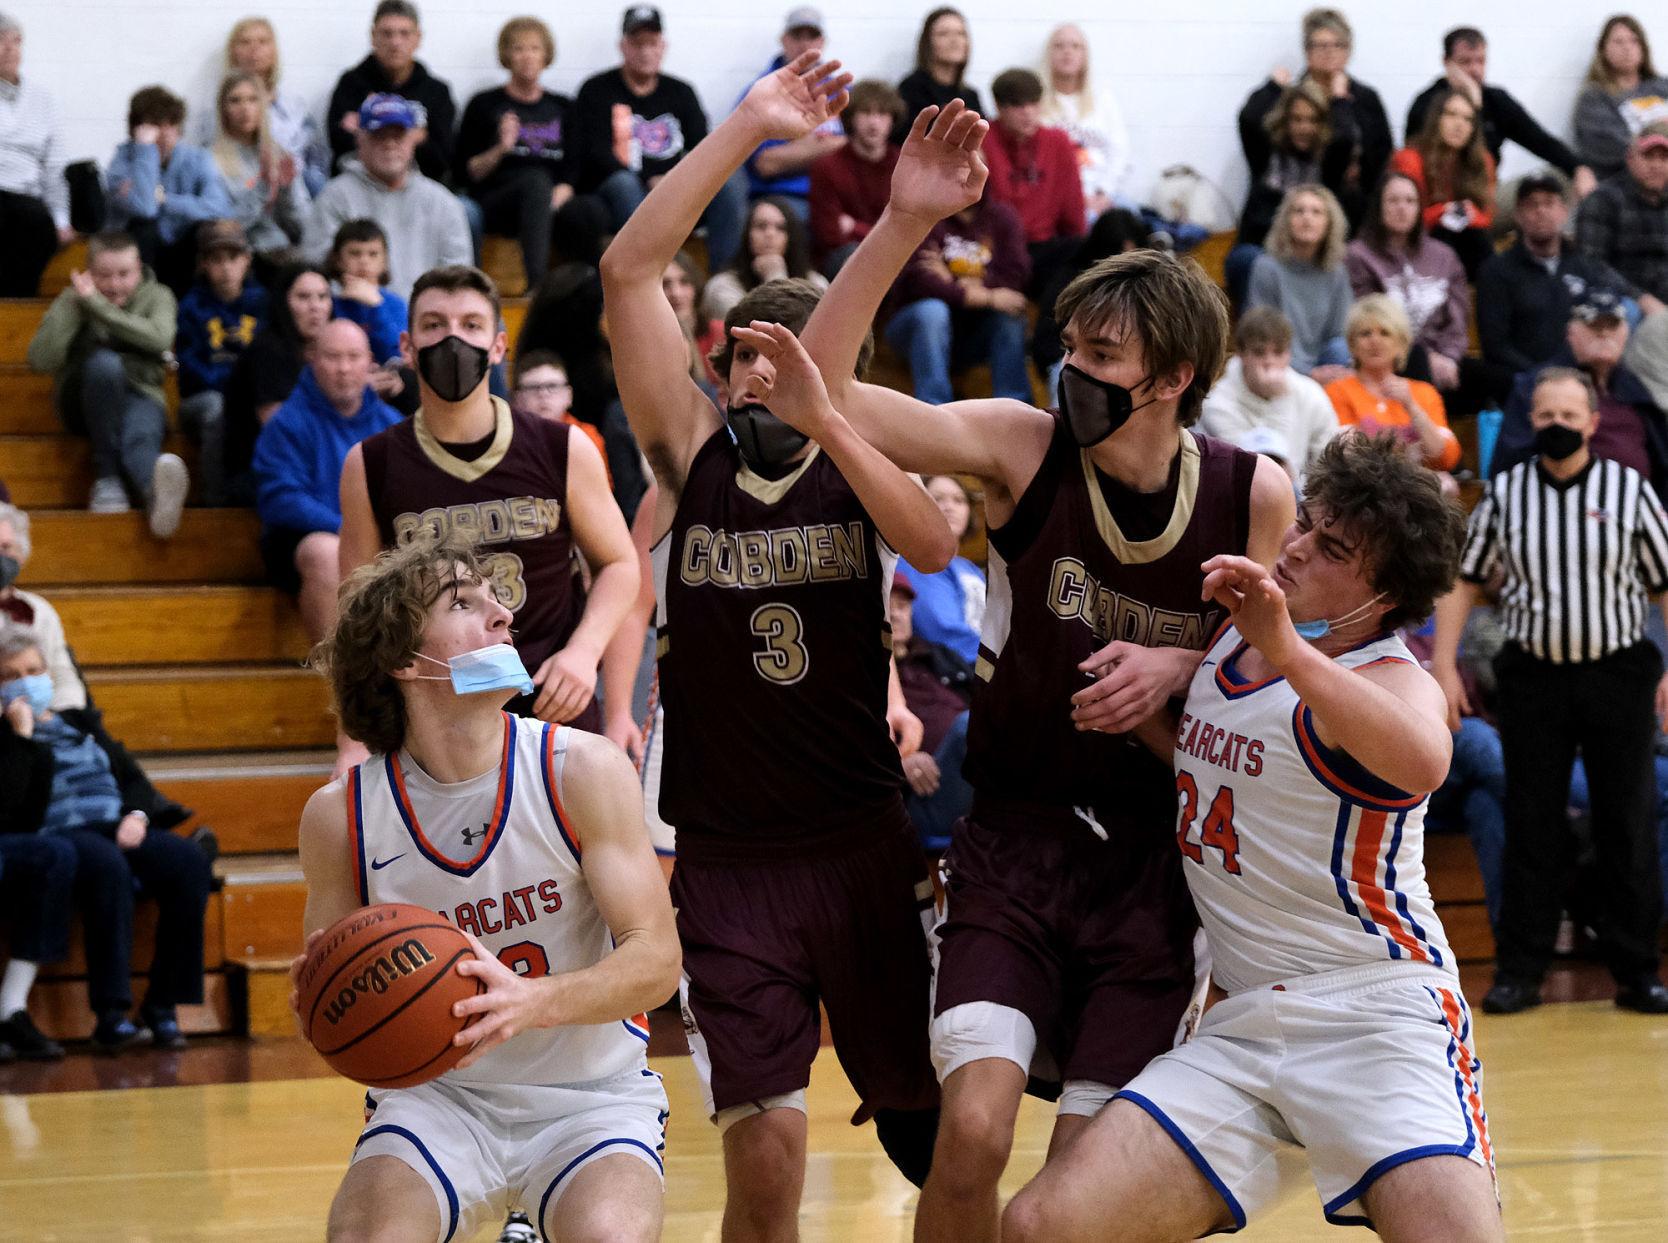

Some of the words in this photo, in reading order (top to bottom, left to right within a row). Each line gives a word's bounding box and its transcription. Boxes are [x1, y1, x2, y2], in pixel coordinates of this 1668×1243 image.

[681, 521, 868, 589] COBDEN
[750, 602, 810, 685] 3
[1176, 712, 1266, 778] EARCATS
[1176, 768, 1243, 876] 24
[438, 878, 563, 938] RCATS
[322, 937, 437, 1026] Wilson
